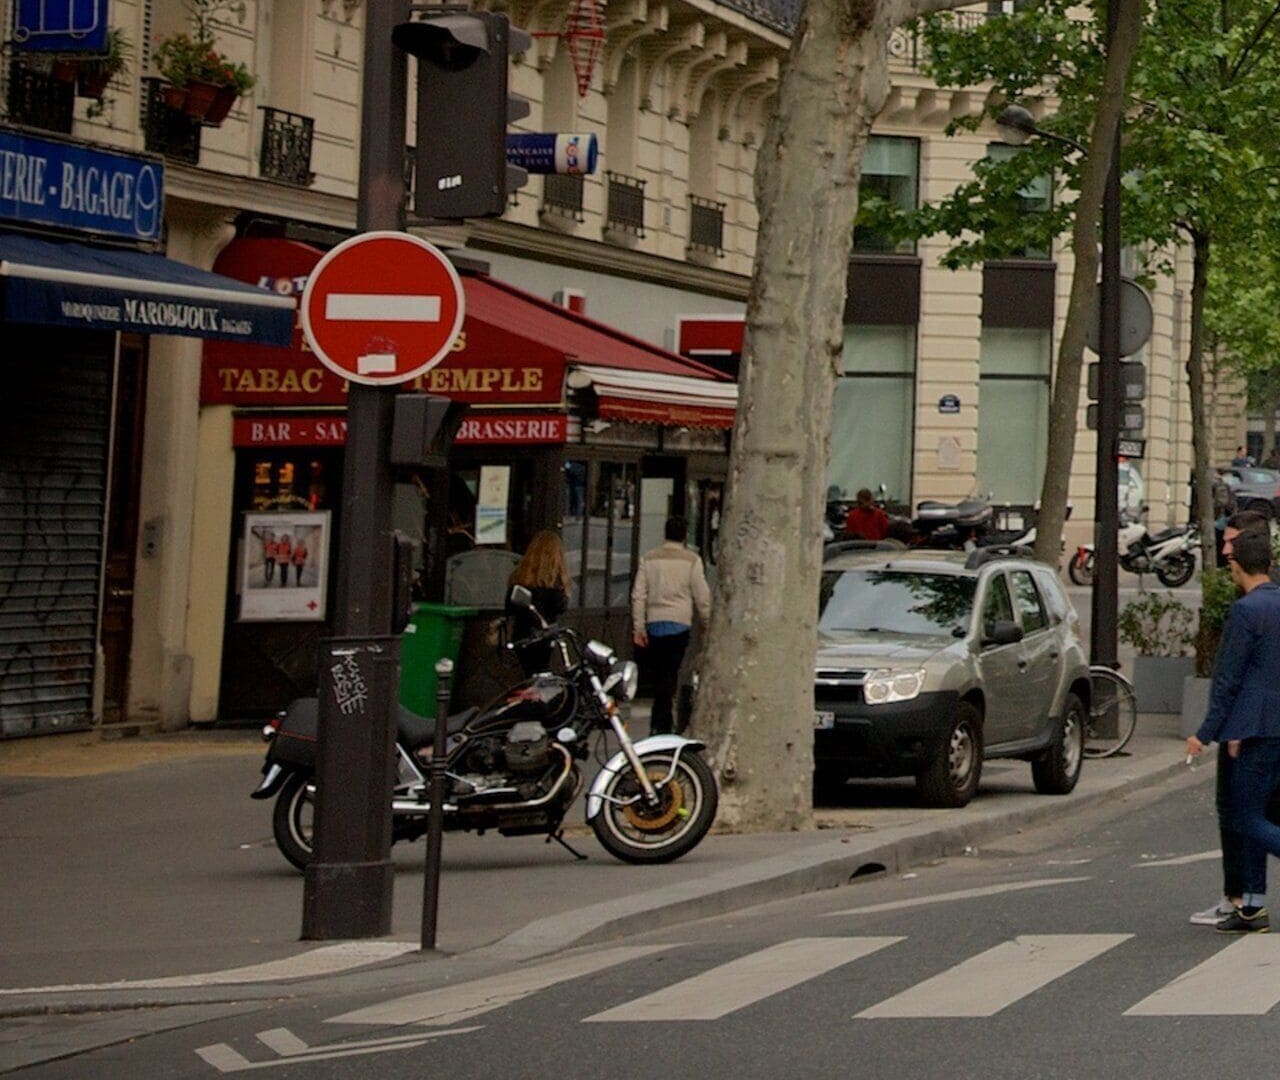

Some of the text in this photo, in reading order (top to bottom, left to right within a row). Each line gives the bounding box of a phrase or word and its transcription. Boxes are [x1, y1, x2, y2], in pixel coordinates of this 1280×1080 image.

[0, 150, 135, 219] ERIE BAGAGE
[124, 297, 219, 332] MAROBIJOUX
[218, 368, 323, 393] TABAC
[411, 367, 544, 394] TEMPLE
[250, 421, 291, 442] BAR
[456, 419, 559, 441] BRASSERIE
